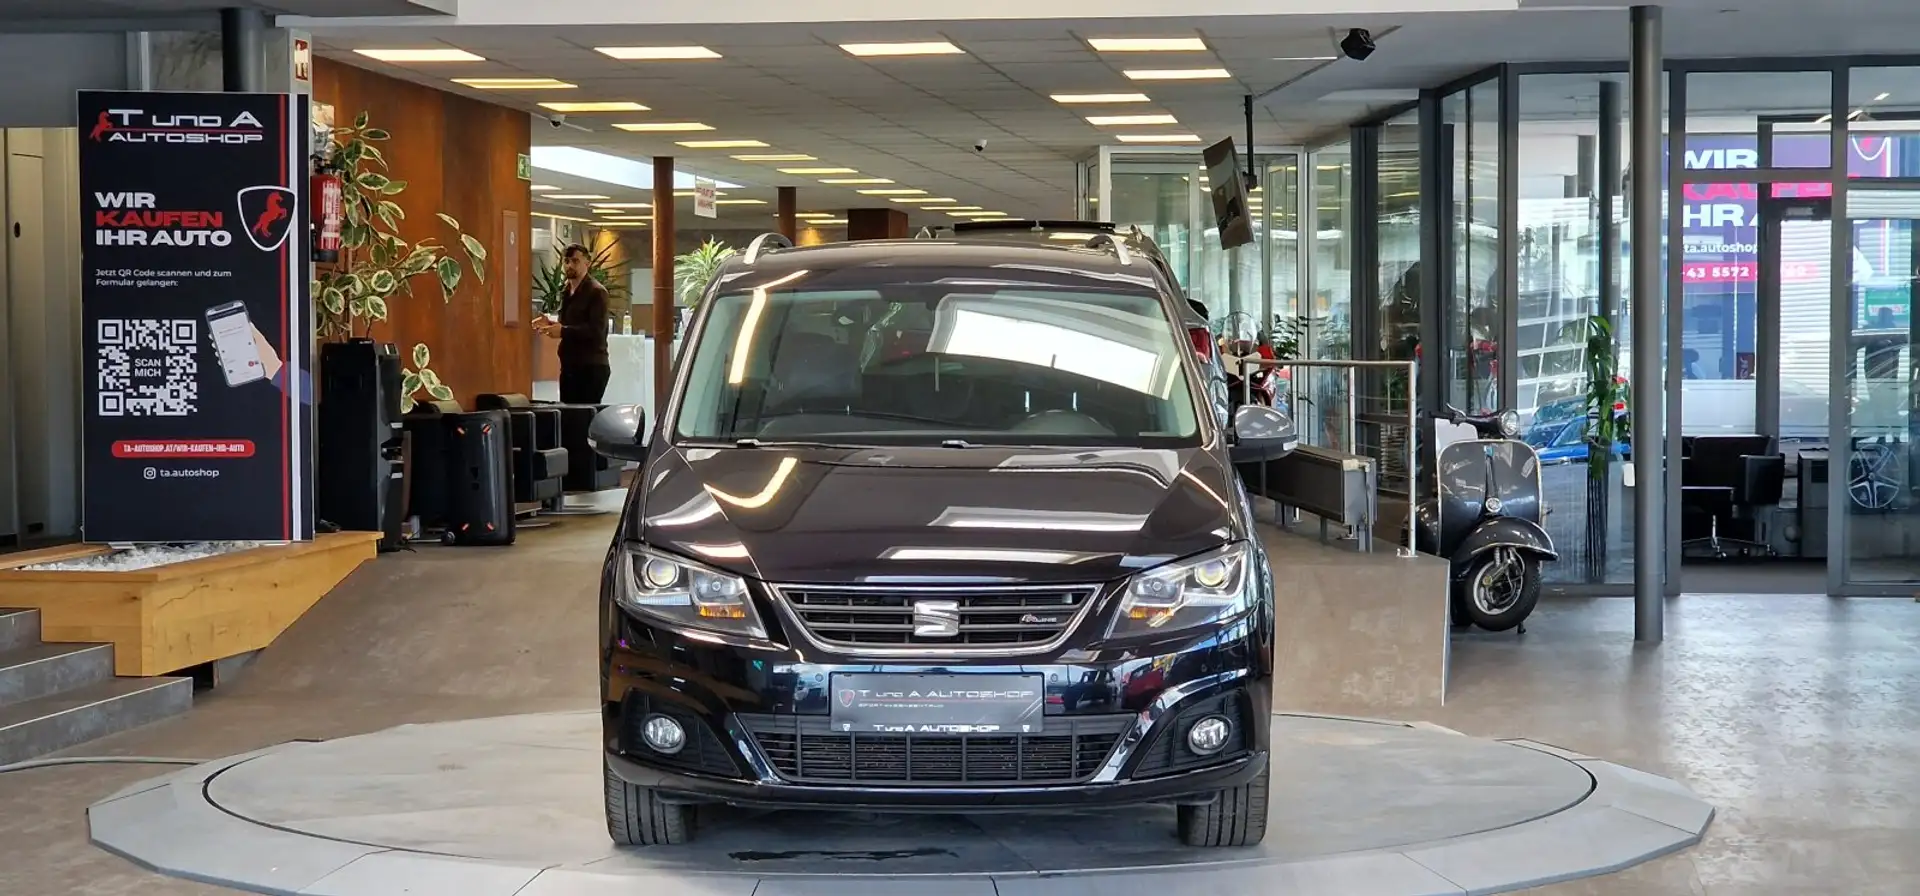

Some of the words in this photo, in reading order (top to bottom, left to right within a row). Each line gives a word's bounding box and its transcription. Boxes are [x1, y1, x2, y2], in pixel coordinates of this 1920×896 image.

[108, 109, 144, 126] T
[229, 110, 263, 128] A
[108, 132, 263, 144] AUTOSHOP
[94, 192, 156, 208] WIR
[96, 212, 222, 227] KAUFEN
[96, 229, 148, 246] IHR
[151, 230, 232, 247] AUTO
[95, 268, 117, 277] Jetzt
[118, 268, 132, 278] QR
[133, 269, 155, 277] Code
[194, 269, 211, 277] und
[1712, 266, 1749, 278] 5572
[136, 279, 179, 288] gelangen:
[134, 358, 162, 367] SCAN
[134, 368, 162, 377] MICH
[159, 468, 220, 478] ta.autoshop
[858, 689, 871, 698] T
[908, 690, 921, 698] A
[926, 690, 1035, 699] AUTOSHOP
[919, 725, 1001, 733] AUTOSHOP
